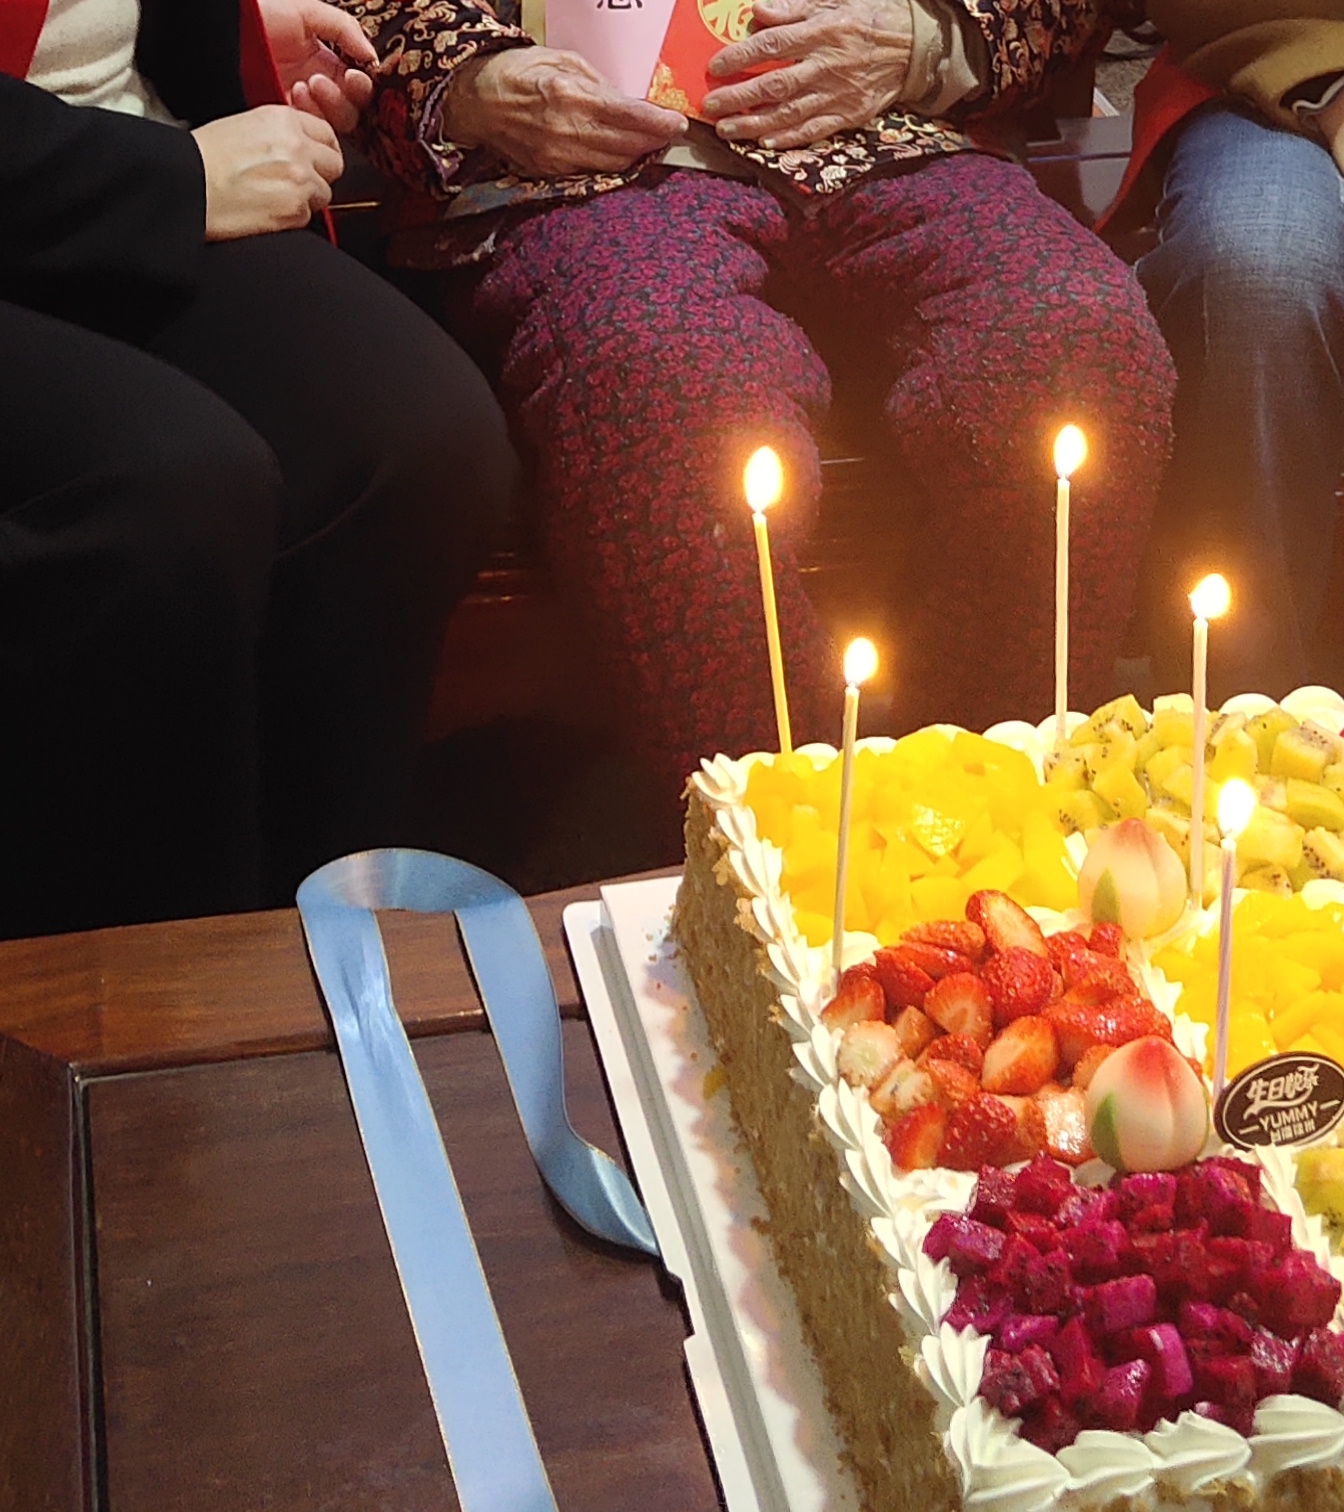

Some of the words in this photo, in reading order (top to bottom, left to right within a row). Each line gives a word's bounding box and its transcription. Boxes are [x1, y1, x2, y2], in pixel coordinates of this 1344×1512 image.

[1243, 1063, 1320, 1120] 生日快乐
[1259, 1100, 1319, 1132] YUMMY
